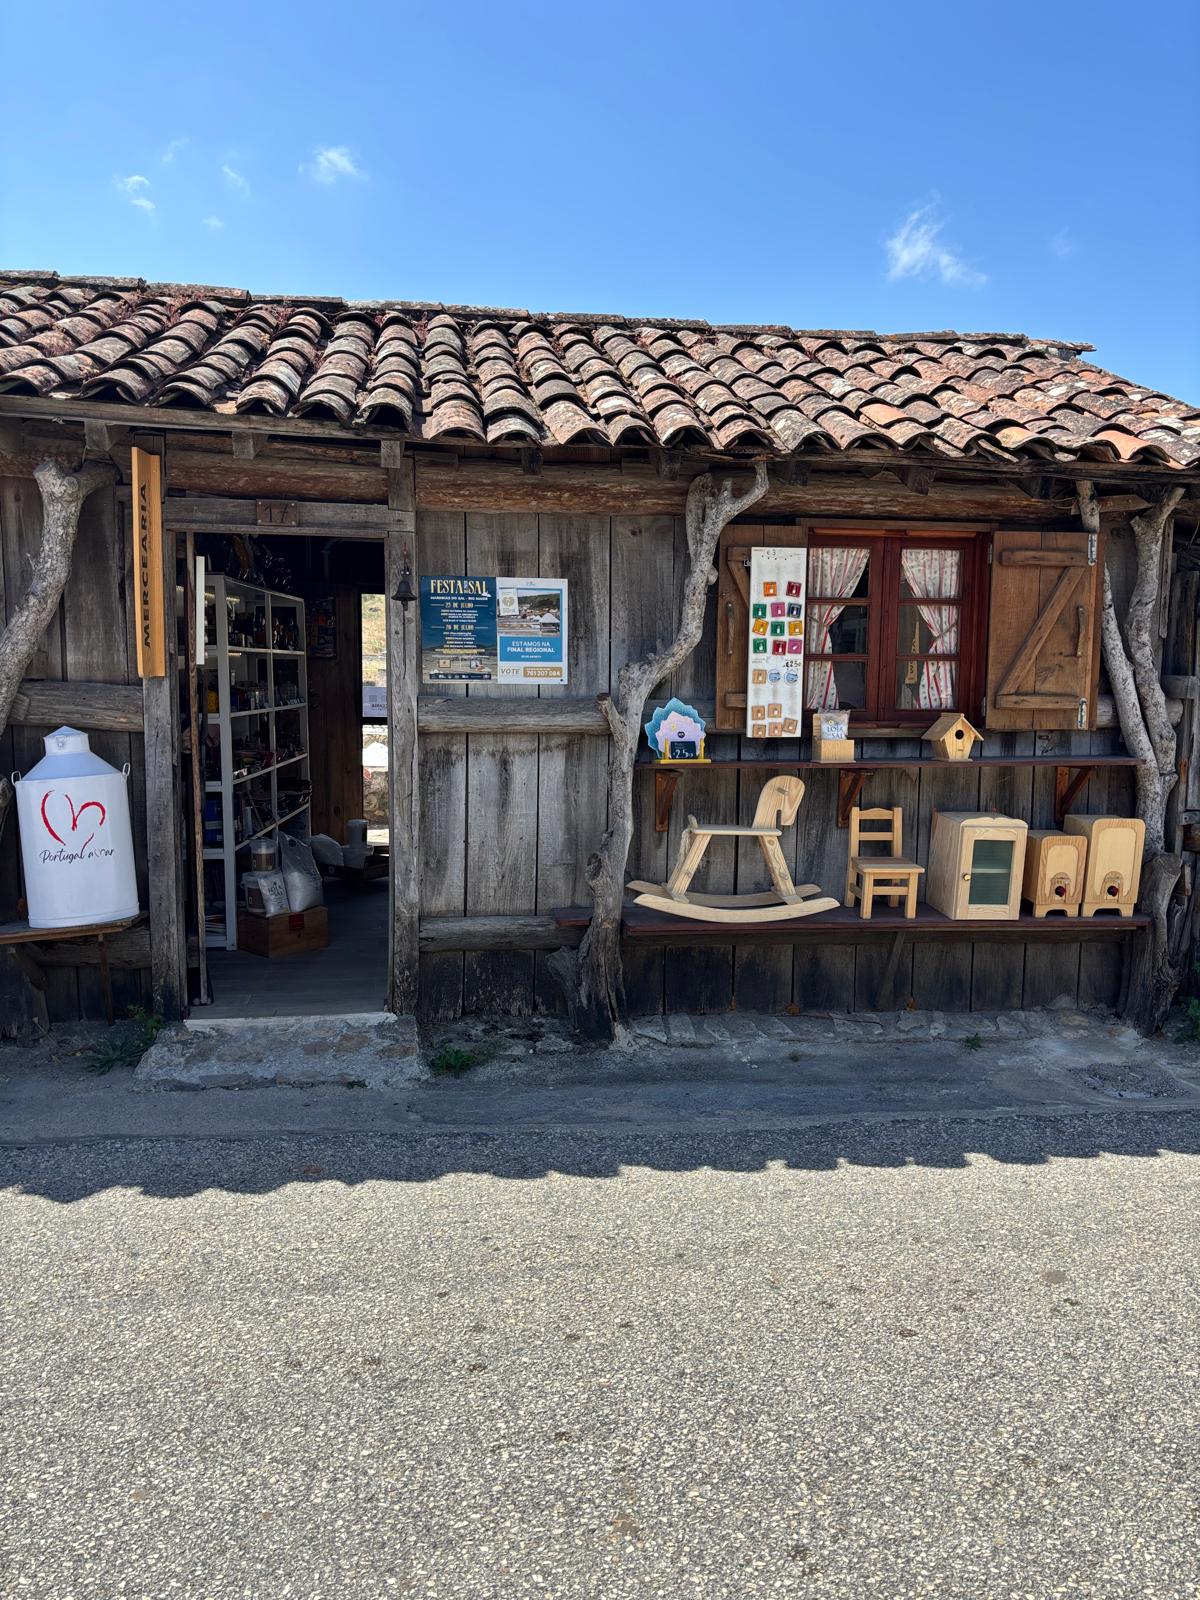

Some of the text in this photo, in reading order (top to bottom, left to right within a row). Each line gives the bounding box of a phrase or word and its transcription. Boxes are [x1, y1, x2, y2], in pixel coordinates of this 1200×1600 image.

[140, 483, 152, 648] MERCEARIA
[430, 579, 463, 594] FESTA
[468, 580, 488, 595] SAL
[40, 846, 85, 864] Portugal
